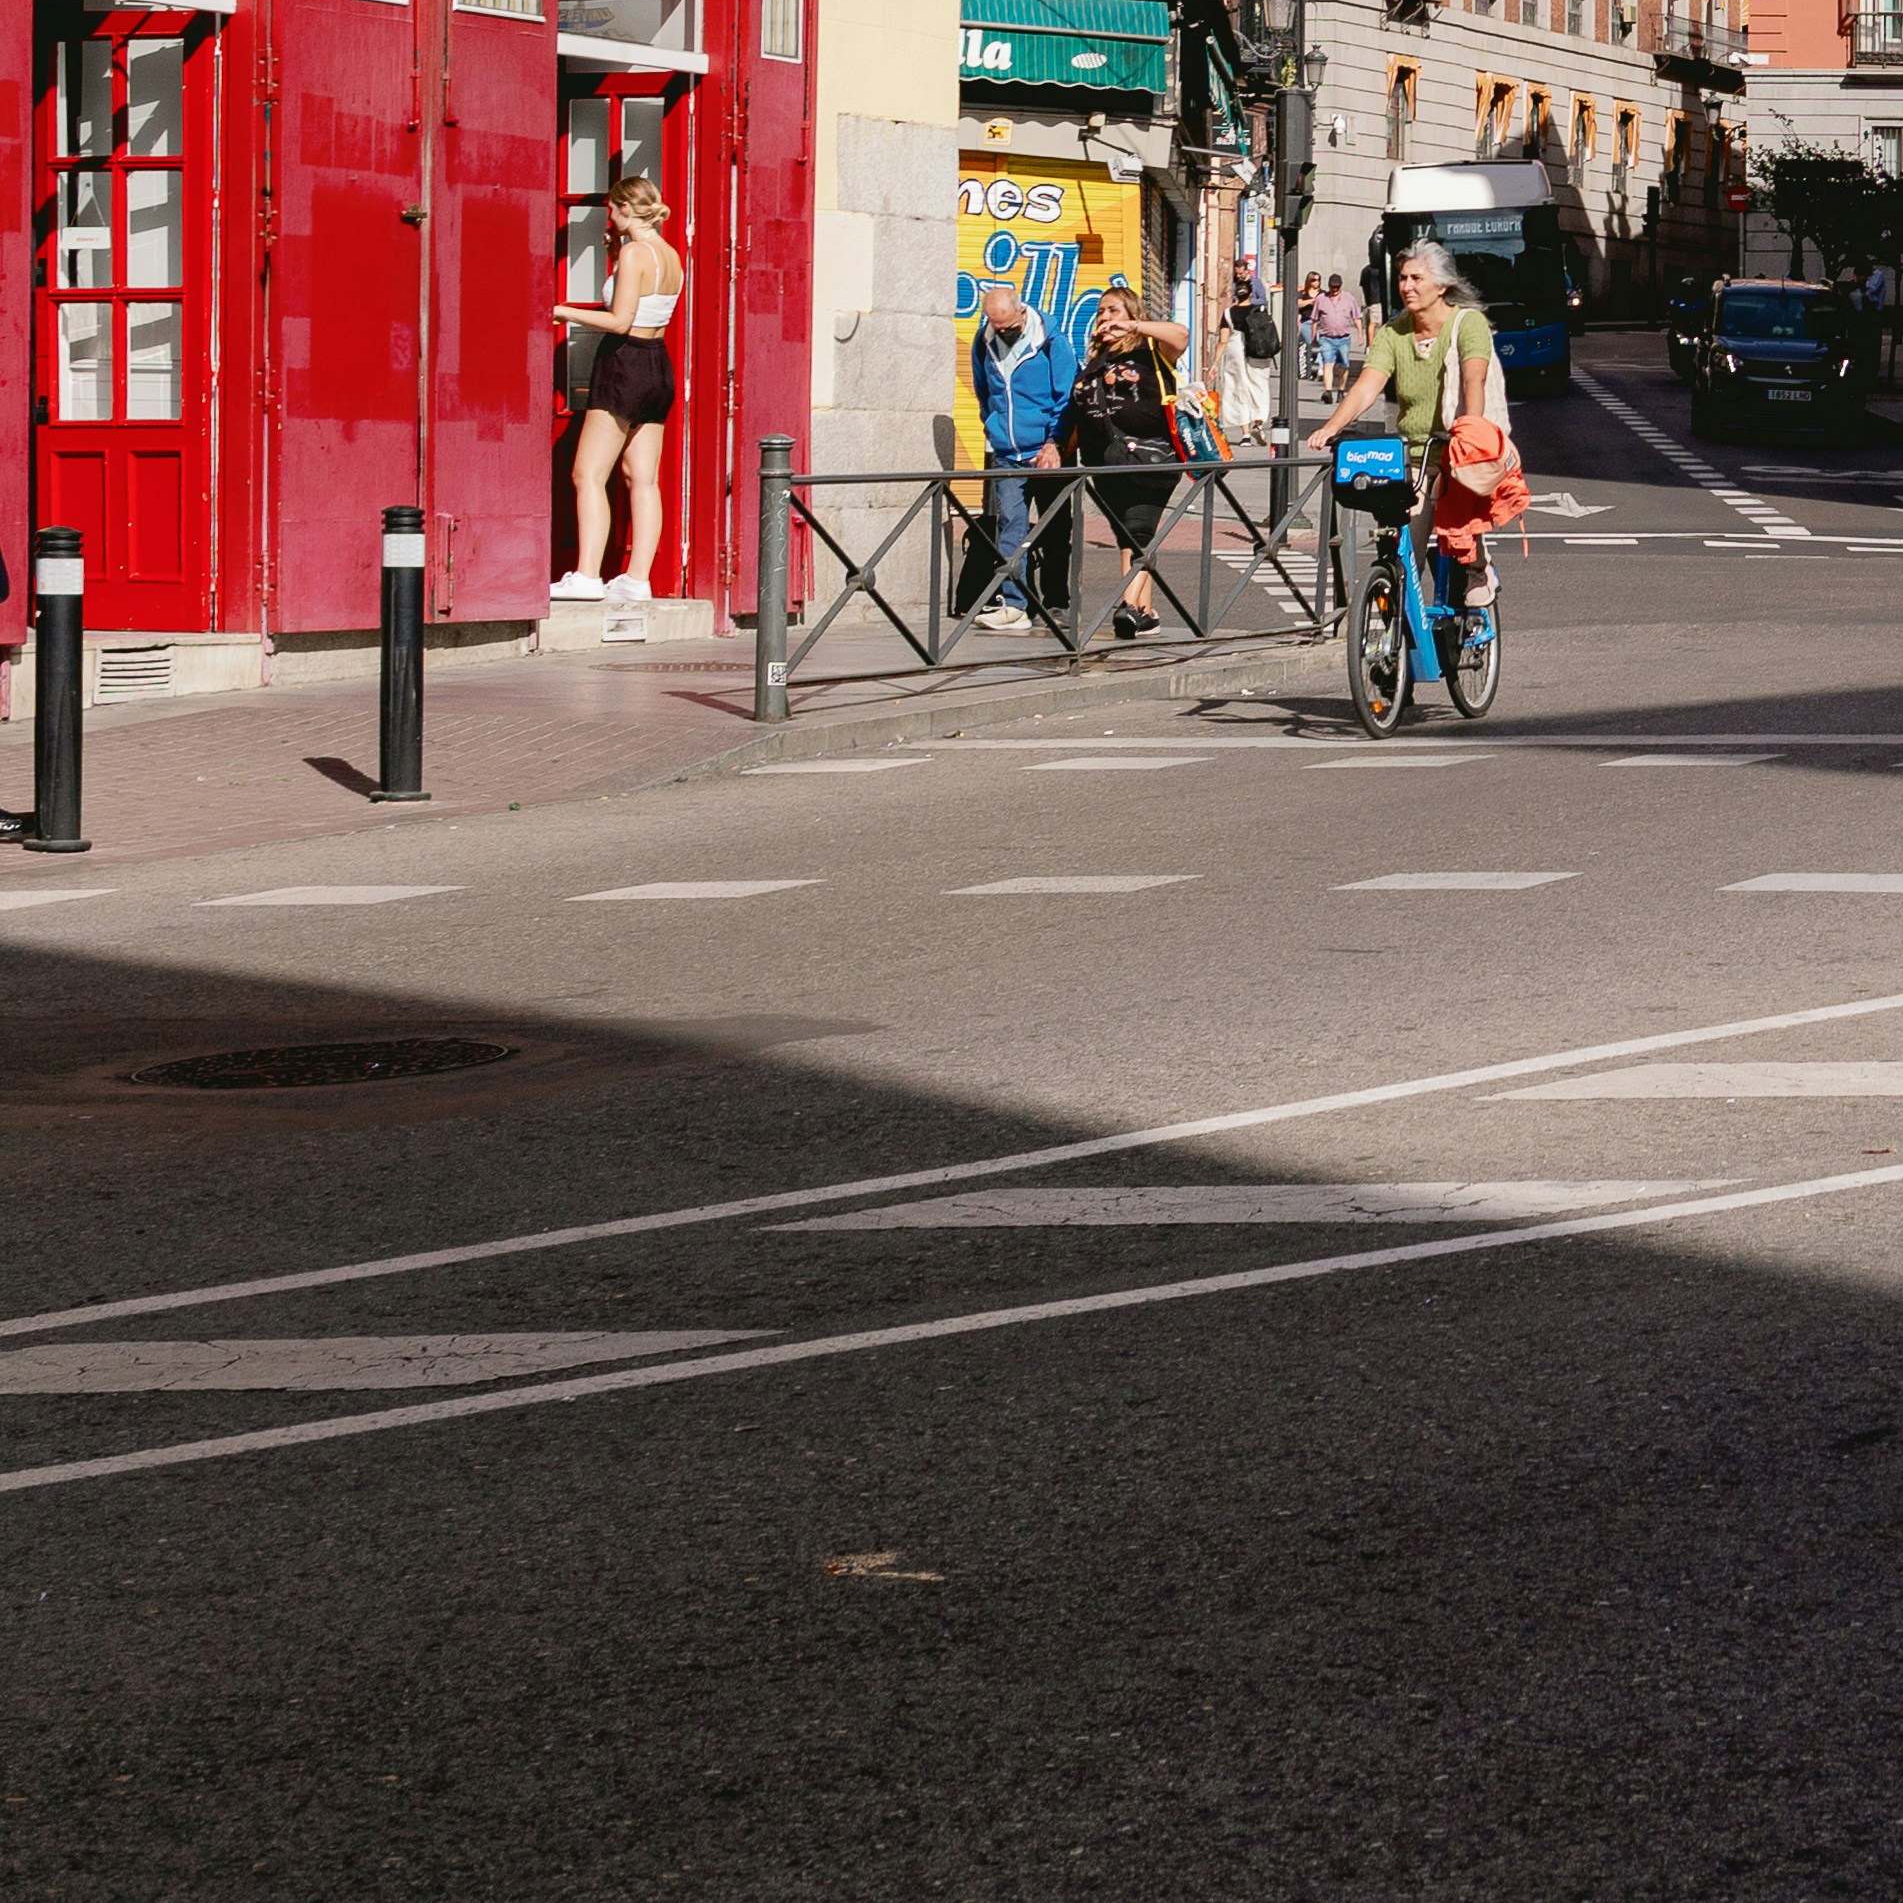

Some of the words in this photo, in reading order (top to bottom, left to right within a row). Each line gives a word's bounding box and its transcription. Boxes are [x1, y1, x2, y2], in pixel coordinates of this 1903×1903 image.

[1447, 222, 1483, 235] PARQUE
[1485, 217, 1522, 233] EUROPA
[1346, 451, 1394, 464] bicimad
